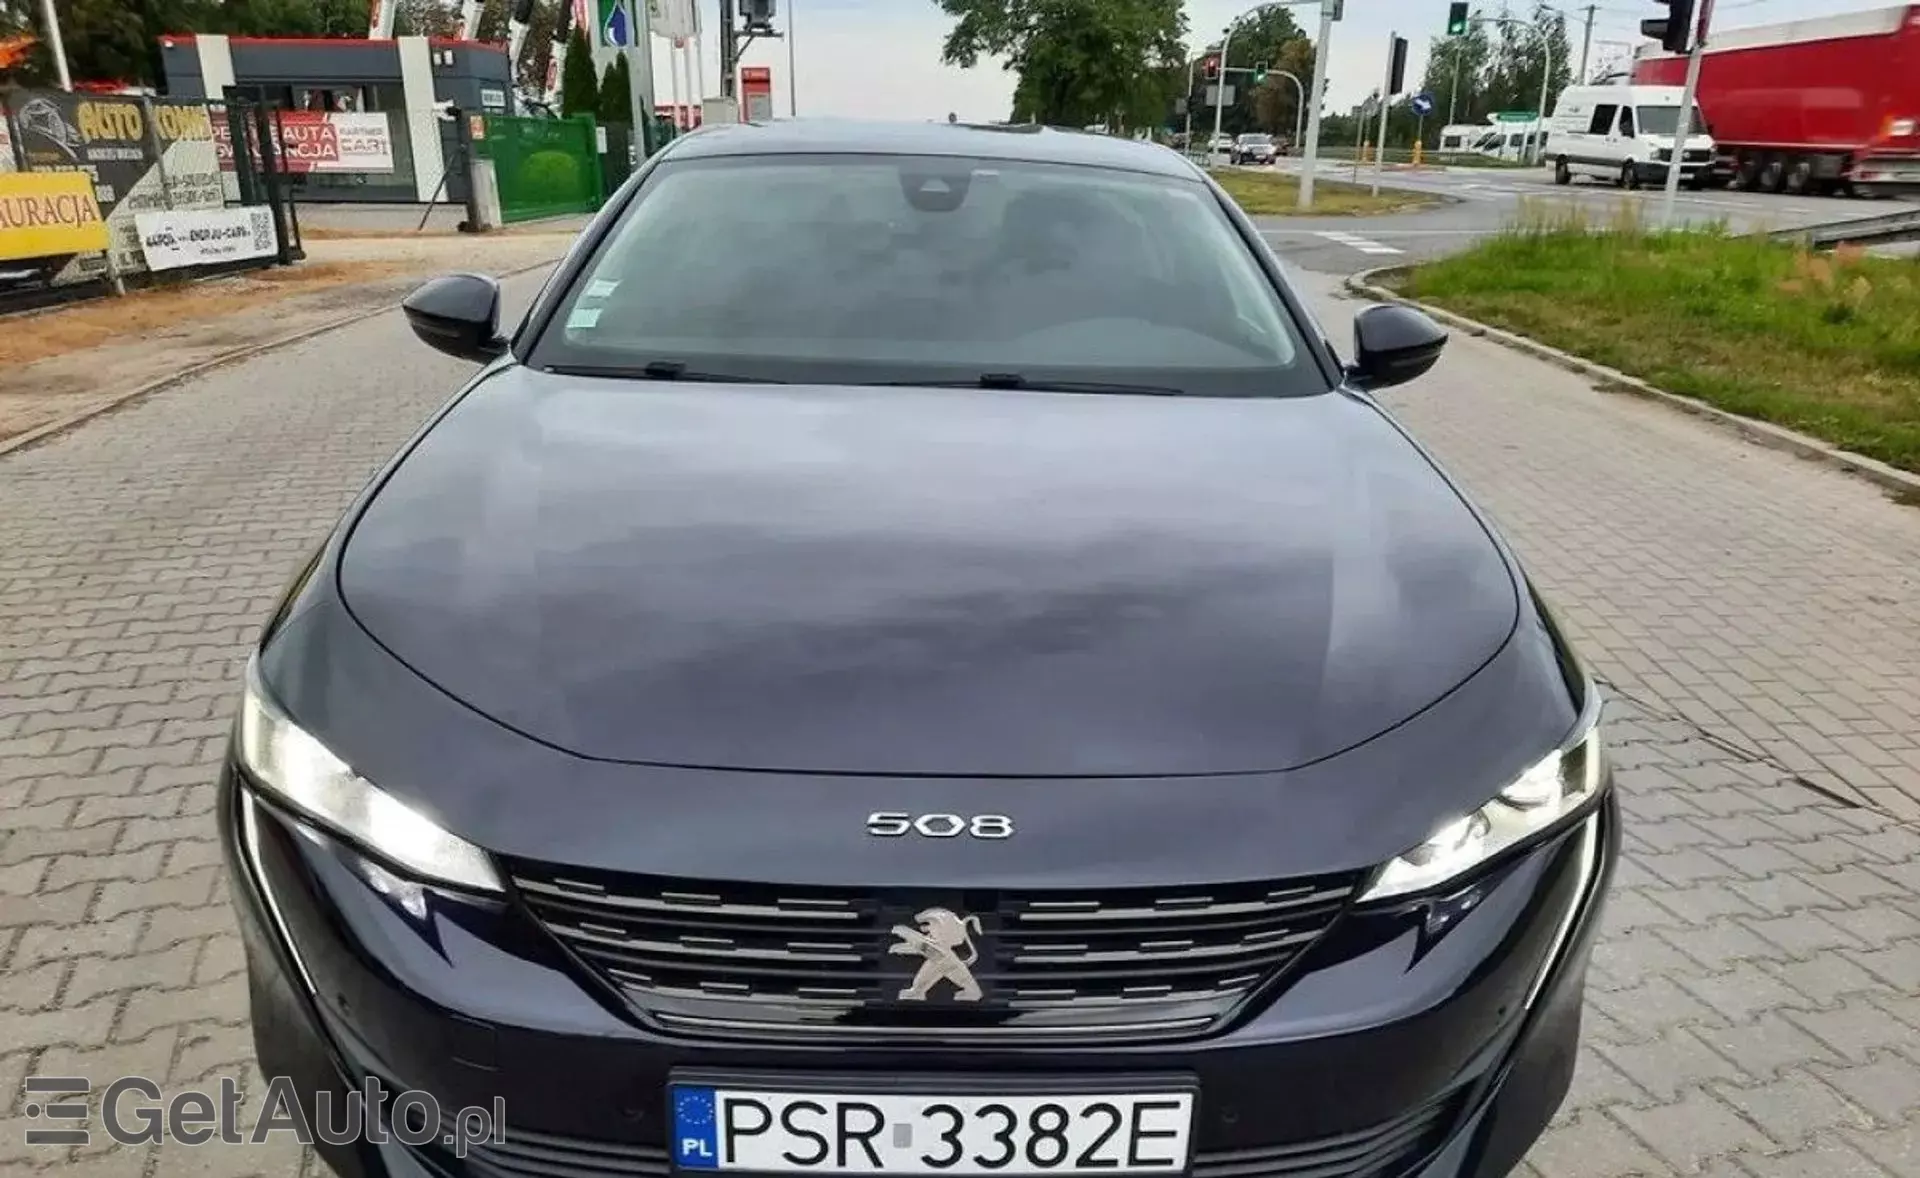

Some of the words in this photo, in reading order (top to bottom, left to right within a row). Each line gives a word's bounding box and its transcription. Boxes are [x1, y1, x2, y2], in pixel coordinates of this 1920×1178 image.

[78, 103, 143, 142] AUTO
[282, 126, 334, 141] AUTA
[866, 811, 1015, 839] 508
[722, 1098, 885, 1168] PSR
[921, 1100, 1181, 1168] 3382E
[681, 1138, 713, 1157] PL
